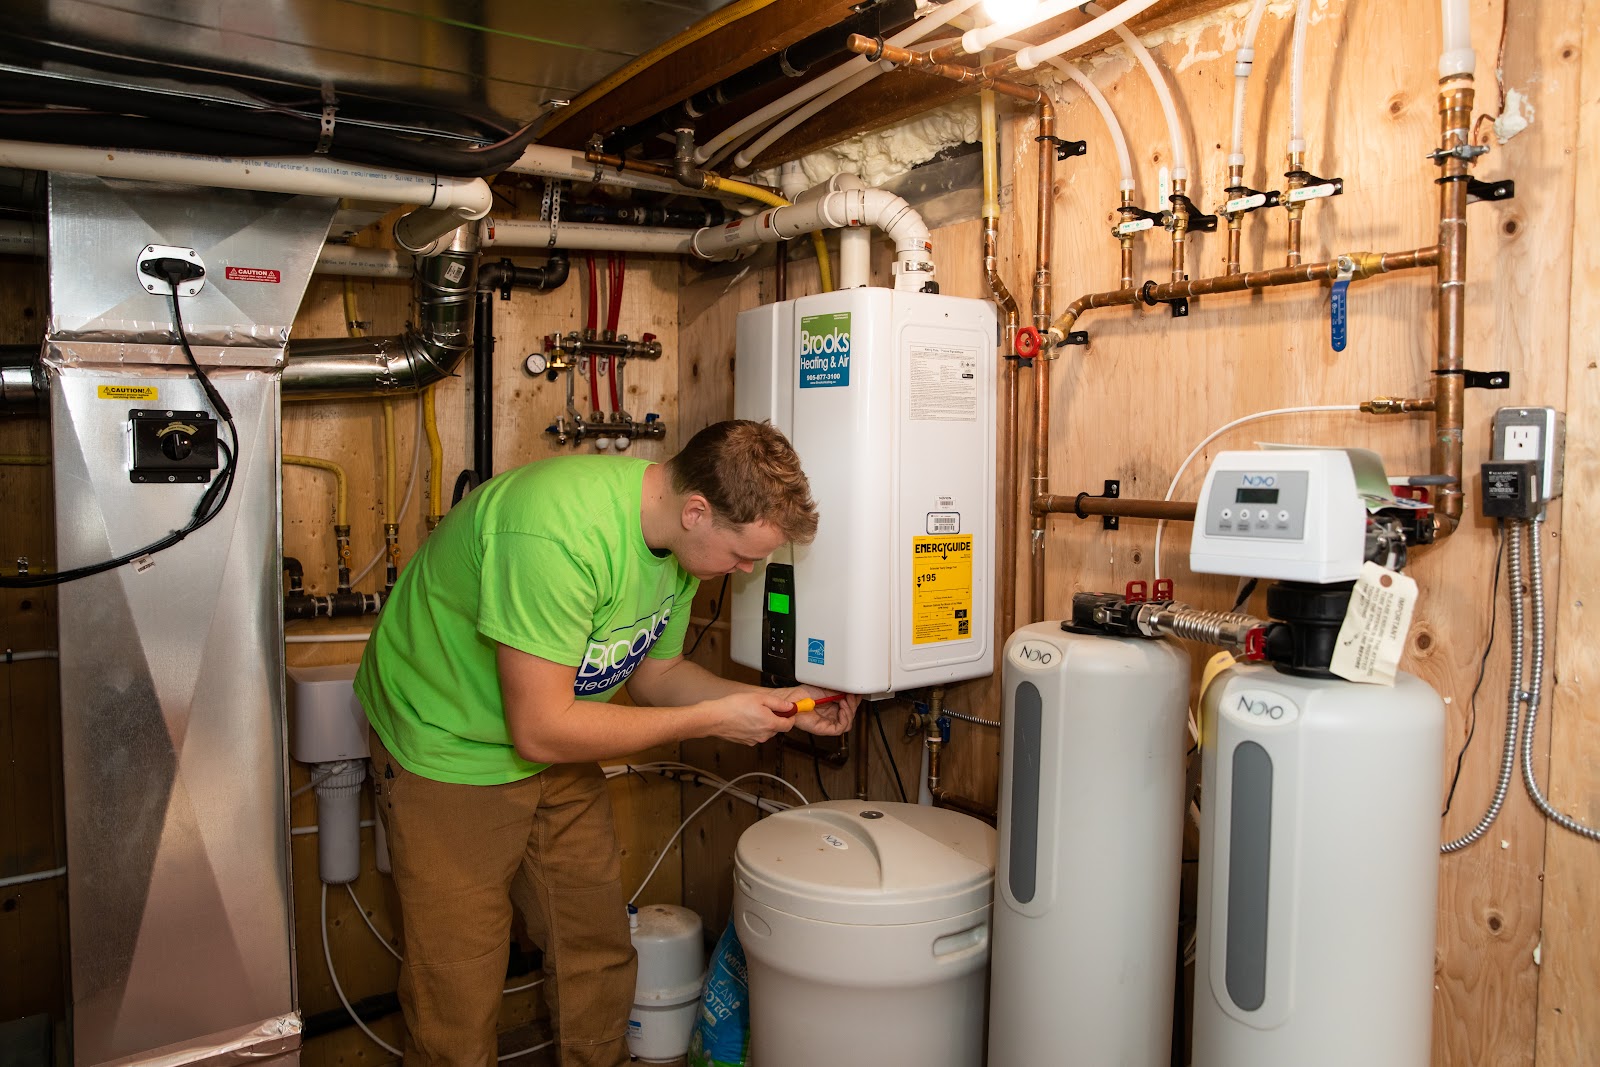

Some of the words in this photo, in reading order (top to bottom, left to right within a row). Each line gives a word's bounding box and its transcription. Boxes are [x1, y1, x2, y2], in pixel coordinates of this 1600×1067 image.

[312, 166, 349, 176] installation
[351, 170, 388, 180] requirements
[801, 327, 850, 356] Brooks
[800, 356, 828, 371] Heating
[830, 356, 836, 368] &
[838, 354, 850, 368] Air
[1242, 474, 1275, 487] NOVO
[915, 542, 970, 555] ENERGYGUIDE
[917, 574, 936, 582] $195
[1390, 597, 1405, 640] IMPORTANT
[1020, 645, 1052, 664] NOVO
[574, 662, 636, 692] Heating
[1237, 696, 1284, 720] NOVO
[724, 950, 748, 983] windso
[709, 974, 736, 1006] LEAN
